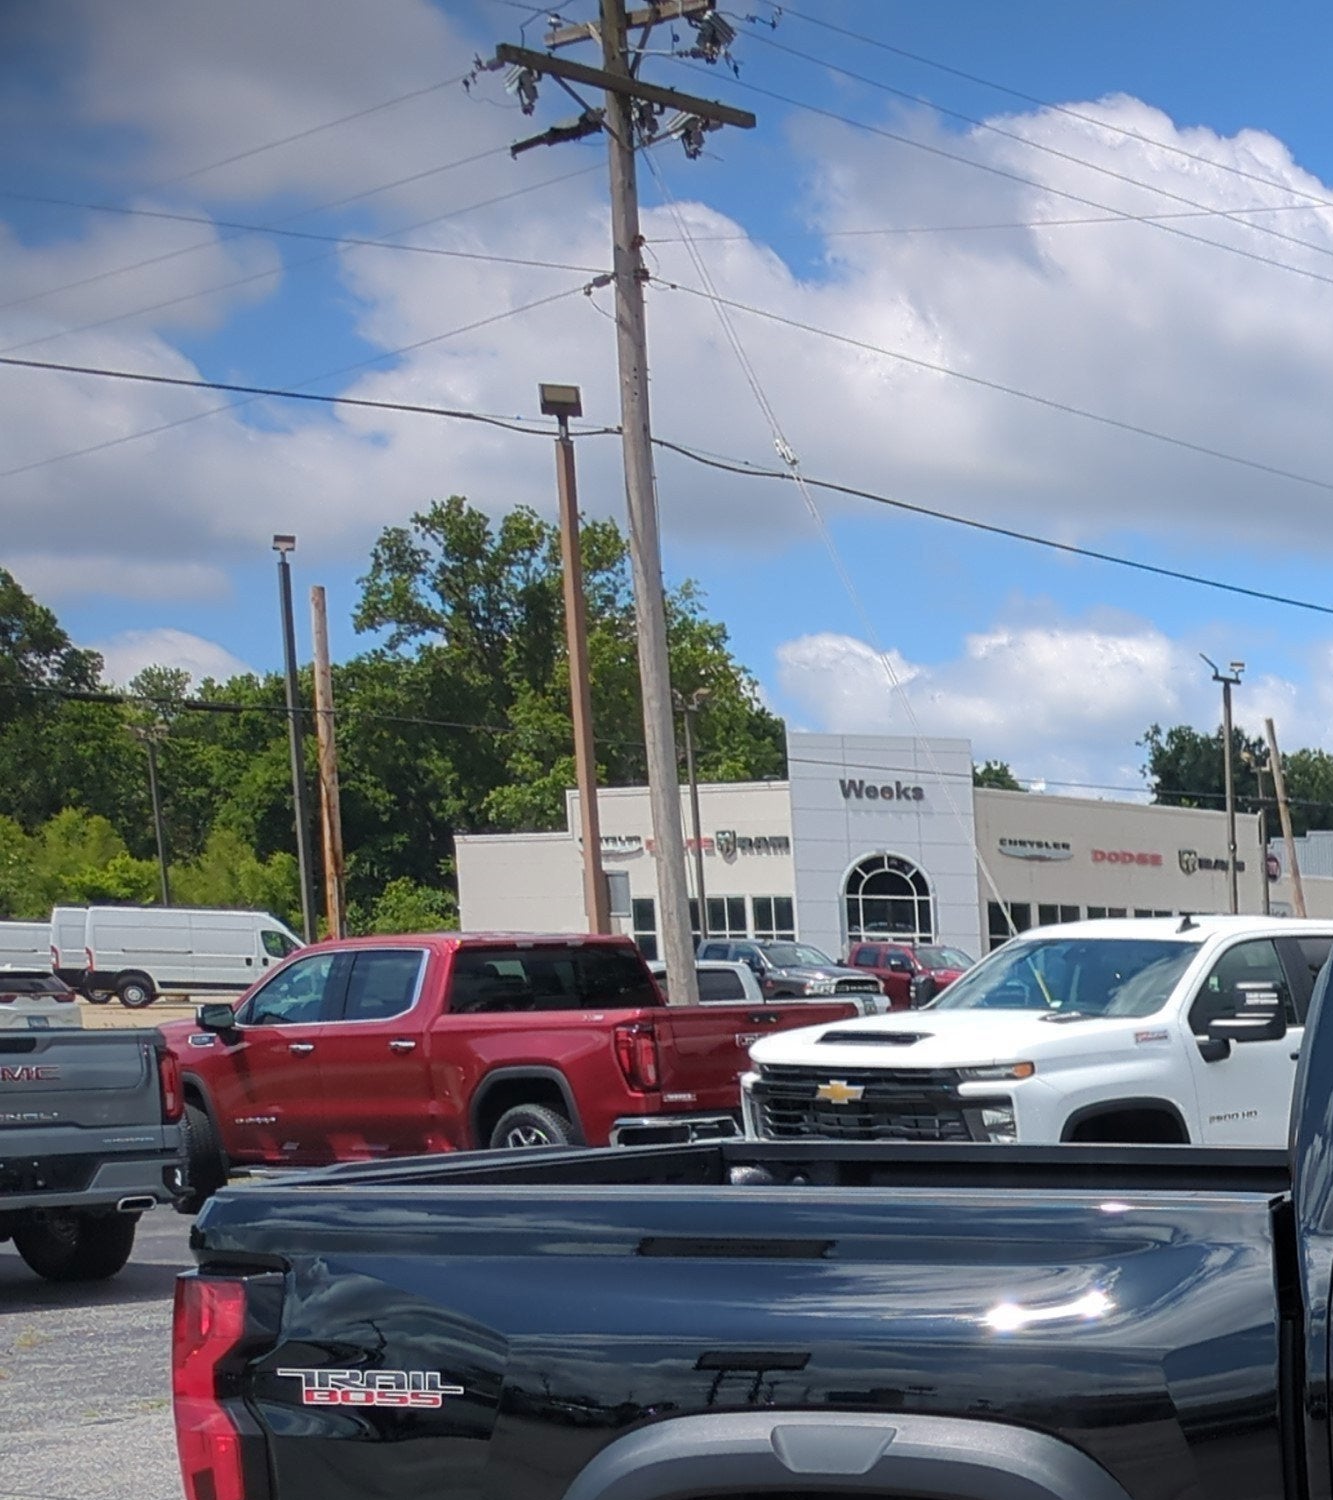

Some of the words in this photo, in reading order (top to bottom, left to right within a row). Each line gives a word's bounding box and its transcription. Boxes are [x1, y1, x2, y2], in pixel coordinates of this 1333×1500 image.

[839, 778, 924, 801] Weeks
[737, 836, 790, 851] RAM
[999, 837, 1070, 850] CHRYSLER
[1091, 850, 1163, 866] DODGE
[0, 1065, 61, 1082] MC
[276, 1368, 465, 1395] TRAIL
[303, 1387, 442, 1408] BOSS
